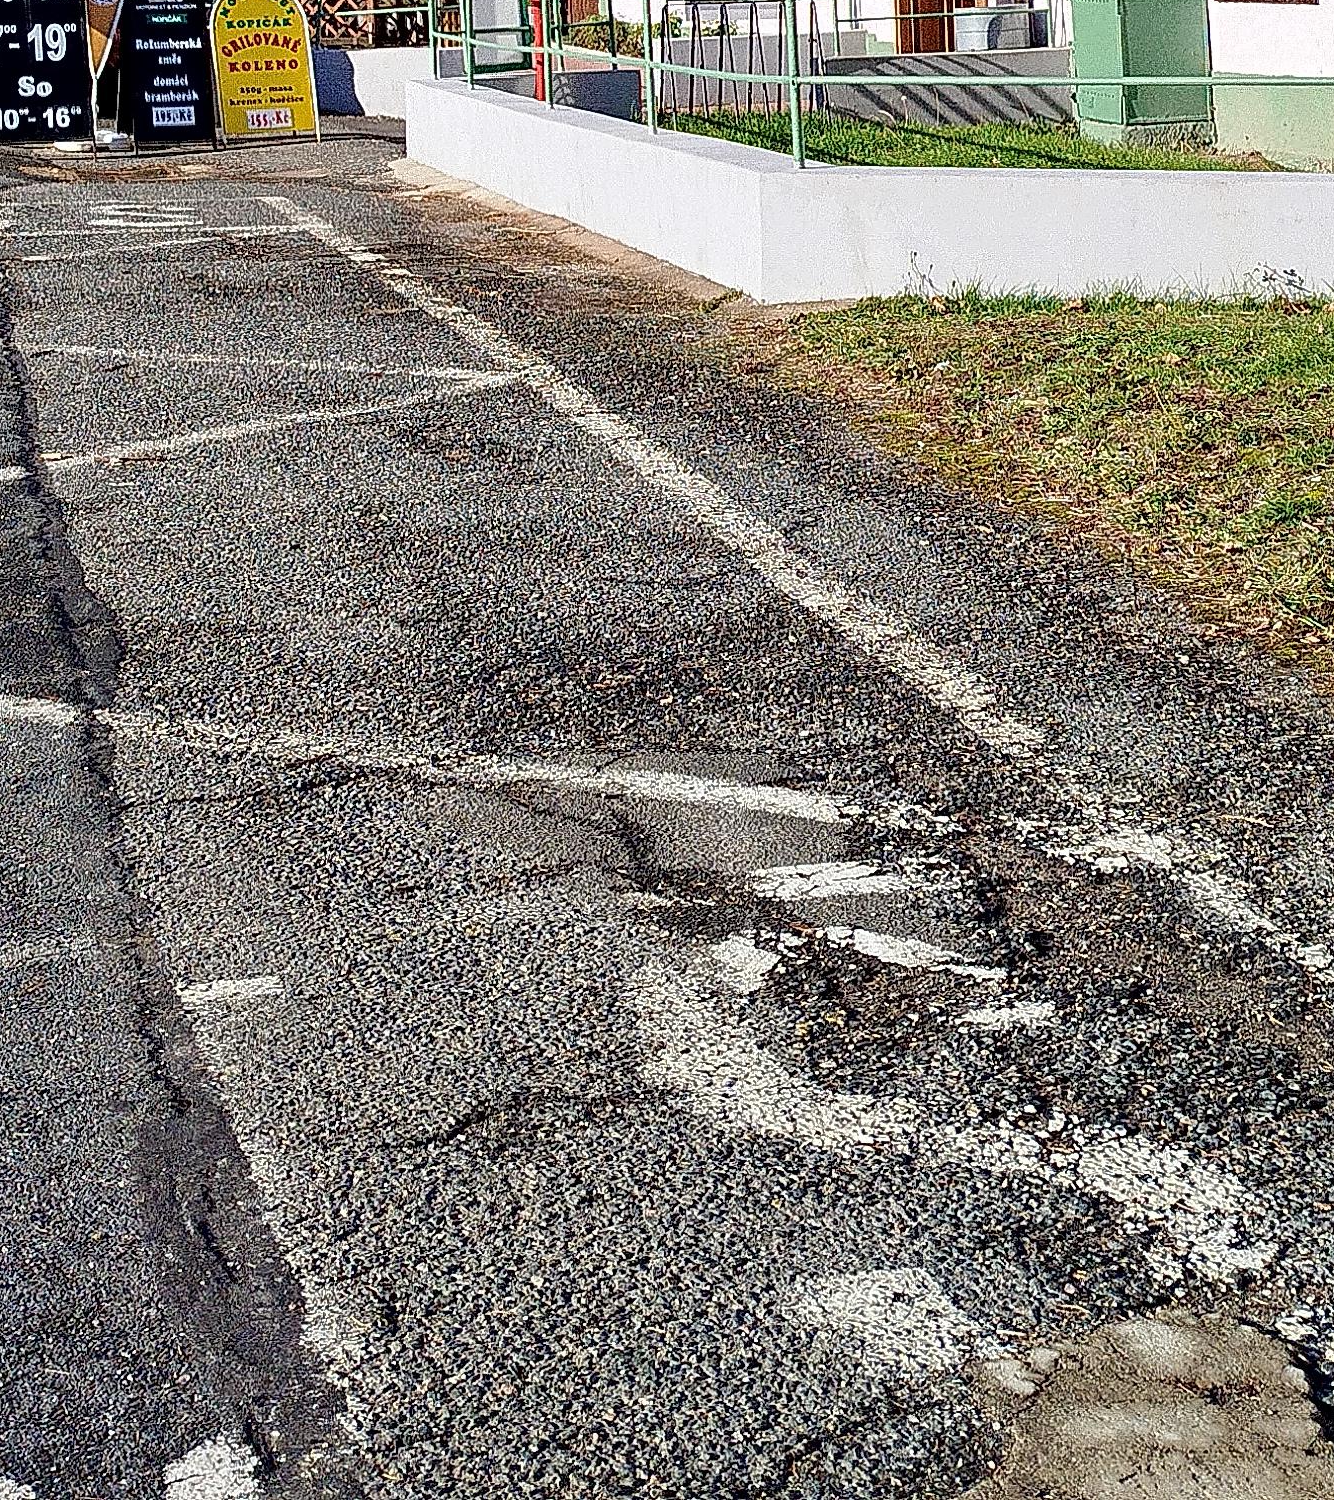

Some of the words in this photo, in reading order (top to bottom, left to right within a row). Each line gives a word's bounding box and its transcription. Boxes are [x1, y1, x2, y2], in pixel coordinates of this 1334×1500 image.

[225, 16, 292, 29] KOPIČÁK
[221, 32, 302, 58] GRILOVANÉ
[158, 52, 182, 65] směs
[228, 58, 299, 73] KOLENO
[17, 76, 53, 97] So
[153, 73, 189, 87] domácí
